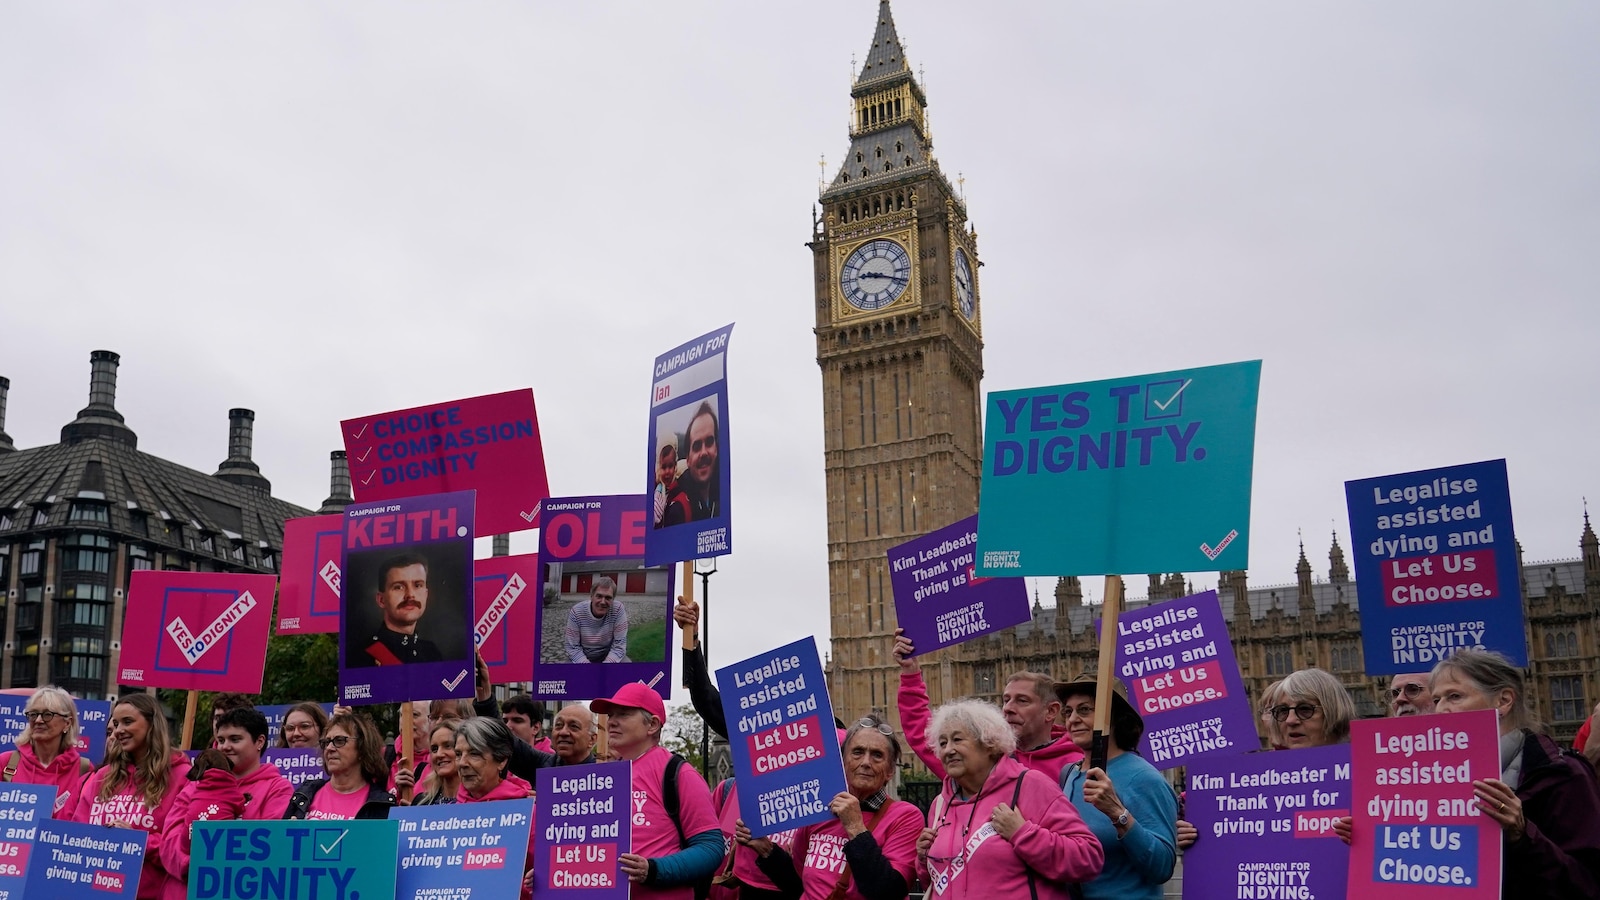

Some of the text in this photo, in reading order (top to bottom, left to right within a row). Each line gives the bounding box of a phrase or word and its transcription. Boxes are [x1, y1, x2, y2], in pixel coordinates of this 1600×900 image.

[655, 332, 727, 378] CAMPAIGN FOR
[655, 383, 670, 402] Ian
[374, 406, 463, 439] CHOICE
[995, 391, 1091, 434] YES
[377, 419, 534, 463] COMPASSION
[992, 421, 1207, 477] DIGNITY.
[381, 451, 479, 485] DIGNITY
[1373, 477, 1478, 505] Legalise
[349, 504, 401, 517] CAMPAIGN FOR
[546, 503, 585, 511] CAMPAIGN
[1376, 500, 1481, 530] assisted
[347, 507, 468, 549] KEITH.
[697, 532, 726, 546] DIGNITY
[697, 541, 728, 554] IN DYING.
[893, 532, 978, 573] Kim Leadbeate
[1370, 524, 1494, 558] dying and
[912, 560, 948, 582] Thank
[951, 552, 973, 572] you
[1391, 554, 1476, 579] Let Us
[914, 574, 966, 602] giving us
[1391, 581, 1492, 604] Choose.
[936, 601, 984, 622] CAMPAIGN FOR
[937, 607, 985, 633] DIGNITY
[1118, 606, 1198, 636] Legalise
[171, 621, 193, 650] YES
[938, 619, 991, 643] IN DYING.
[1123, 622, 1205, 656] assisted
[1391, 621, 1485, 636] CAMPAIGN FOR
[1391, 630, 1485, 650] DIGNITY
[1121, 641, 1218, 677] dying and
[1393, 649, 1415, 664] IN
[734, 655, 801, 689] Legalise
[1141, 667, 1208, 693] Let Us
[740, 673, 806, 710] assisted
[1144, 685, 1223, 713] Choose.
[83, 710, 106, 721] MP:
[738, 693, 818, 734] dying and
[754, 722, 809, 751] Let Us
[1148, 717, 1222, 740] CAMPAIGN FOR
[1149, 724, 1223, 751] DIGNITY
[1152, 735, 1234, 763] IN DYING.
[1374, 727, 1469, 758] Legalise
[756, 744, 821, 773] Choose.
[552, 773, 614, 796] Legalise
[1191, 763, 1350, 790] Kim Leadbeater M
[1375, 759, 1471, 785] assisted
[0, 789, 38, 804] alise
[631, 790, 648, 799] OR
[758, 779, 820, 802] CAMPAIGN FOR
[758, 786, 821, 815] DIGNITY
[1216, 789, 1339, 812] Thank you for
[551, 795, 614, 817] assisted
[761, 800, 829, 827] IN DYING.
[1367, 793, 1481, 822] dying and
[89, 815, 103, 826] IN
[398, 813, 527, 832] im Leadbeater MP:
[545, 822, 586, 844] dying
[591, 819, 619, 838] and
[1213, 816, 1291, 838] giving us
[6, 827, 37, 840] and
[39, 830, 143, 856] Kim Leadbeater MP:
[199, 828, 272, 861] YES
[407, 833, 501, 850] Thank you for
[1384, 826, 1461, 850] Let Us
[52, 849, 122, 870] Thank you for
[401, 852, 503, 869] giving us hope.
[556, 845, 606, 863] Let Us
[1238, 862, 1311, 871] CAMPAIGN FOR
[46, 865, 122, 889] giving us hope.
[196, 867, 361, 900] DIGNITY.
[553, 869, 613, 887] Choose.
[937, 875, 949, 890] TO
[1237, 871, 1311, 886] DIGNITY
[1379, 857, 1472, 885] Choose.
[456, 887, 471, 895] FOR
[1237, 885, 1315, 900] IN DYING.
